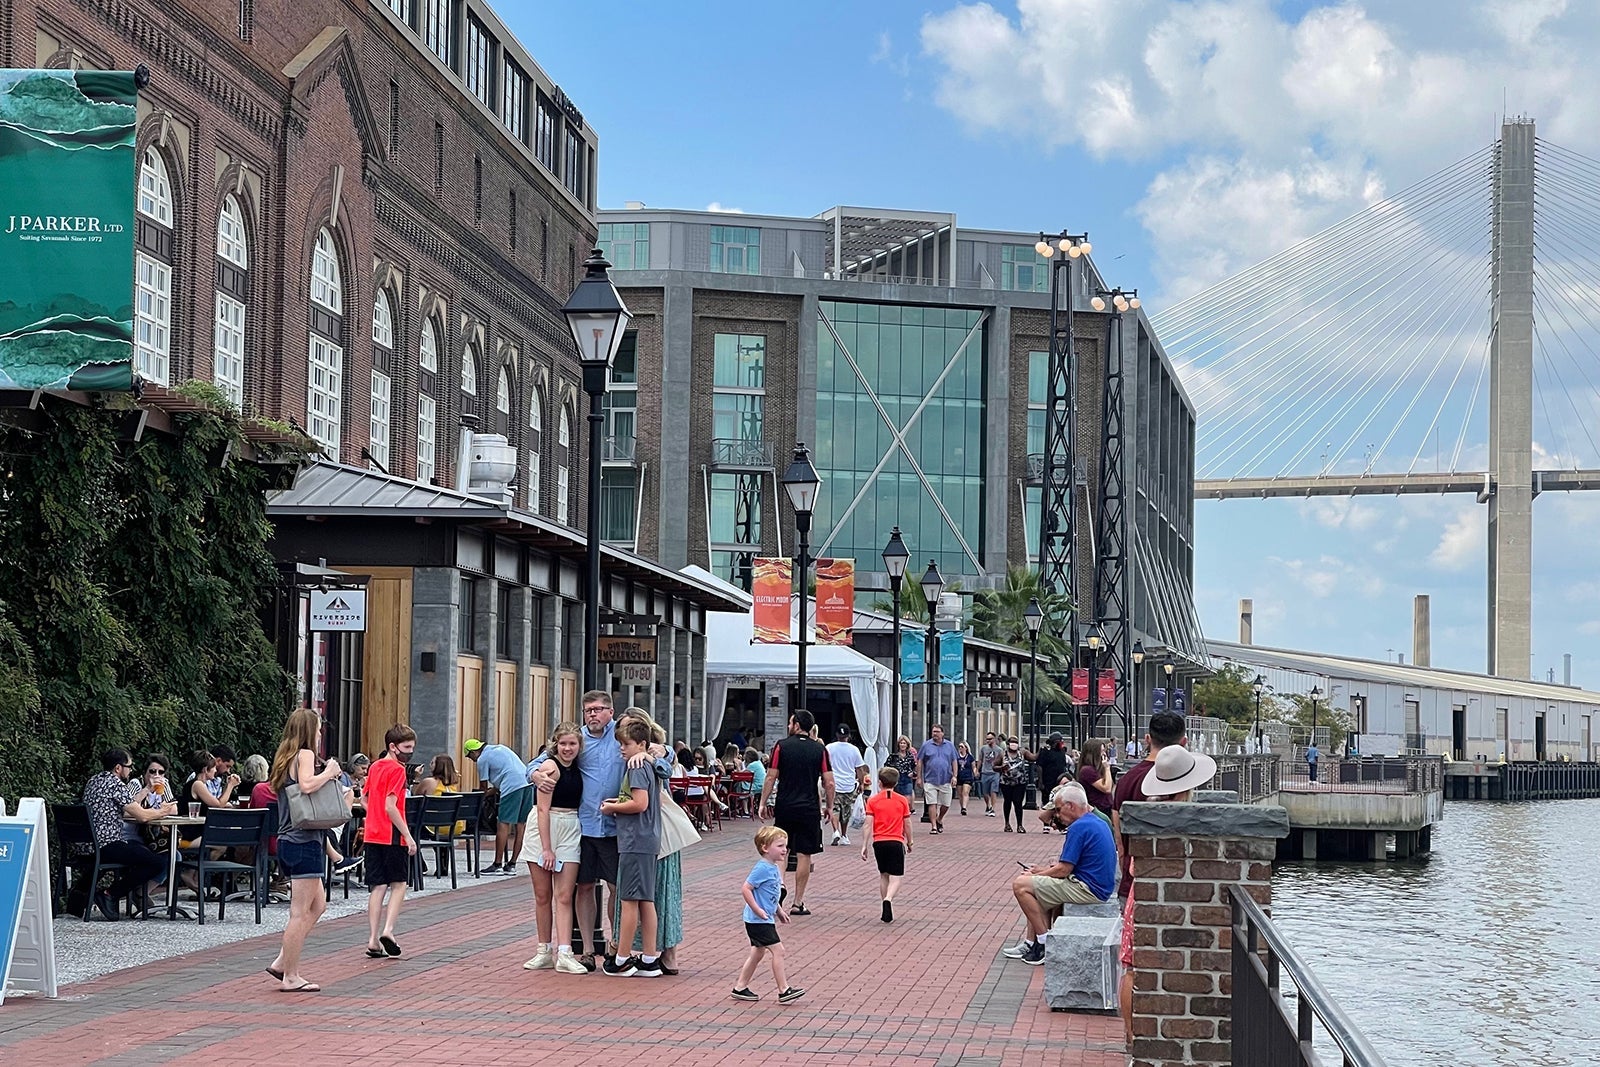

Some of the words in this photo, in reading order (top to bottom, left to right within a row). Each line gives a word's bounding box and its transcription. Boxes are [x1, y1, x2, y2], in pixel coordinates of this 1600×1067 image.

[20, 215, 101, 232] PARKER
[19, 234, 40, 242] Suiting
[756, 595, 775, 603] ELECTRIC
